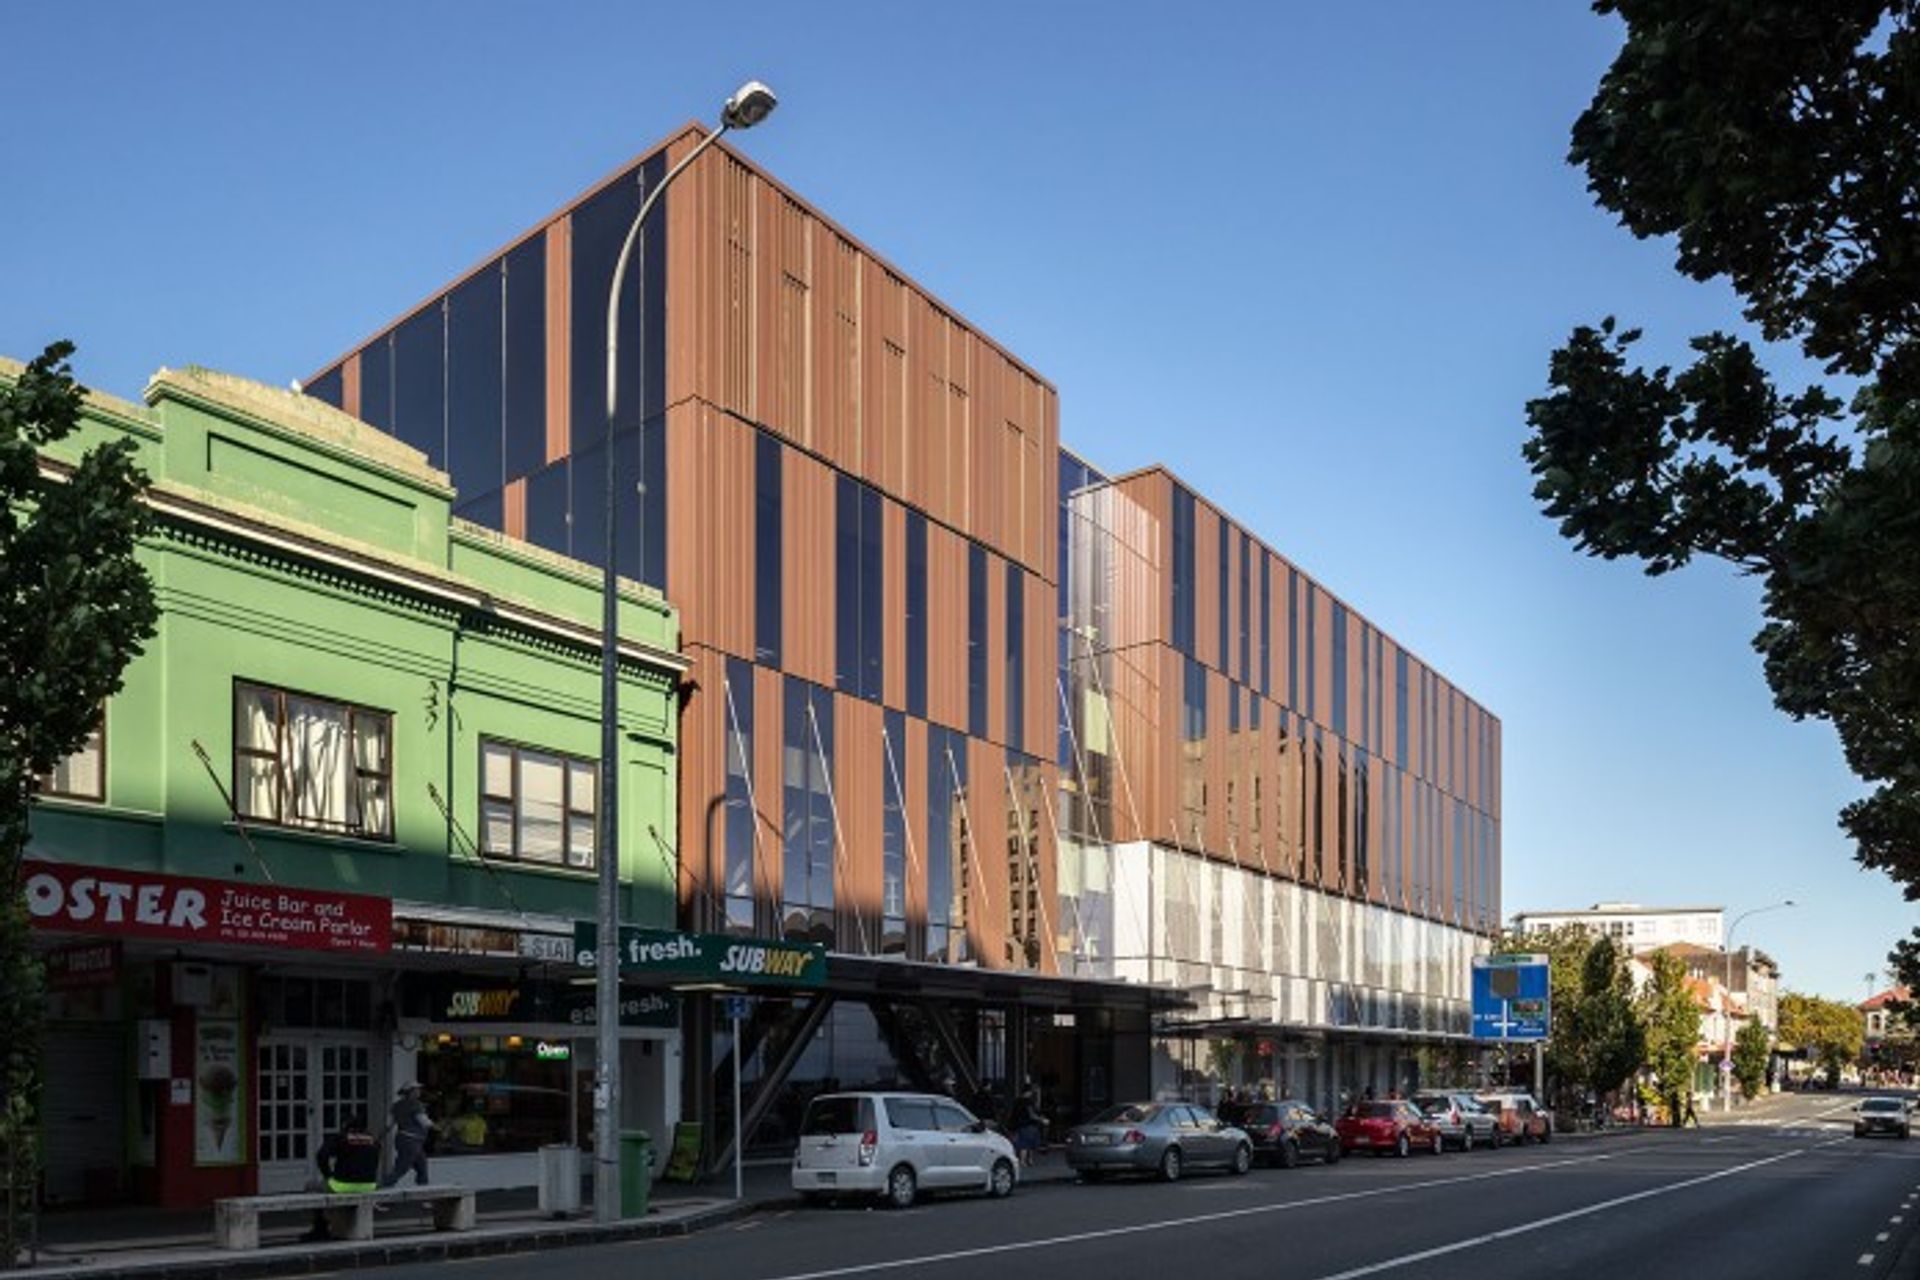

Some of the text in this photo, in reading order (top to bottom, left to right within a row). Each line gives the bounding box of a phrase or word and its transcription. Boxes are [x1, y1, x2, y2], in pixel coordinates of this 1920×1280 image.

[221, 890, 344, 917] Juice Bar and
[221, 910, 371, 936] Ice Cream Parlor
[629, 935, 702, 963] fresh.
[720, 945, 814, 977] SUBWAY
[447, 990, 519, 1016] SUBWAY
[619, 993, 669, 1015] resh.
[537, 1041, 570, 1059] Open
